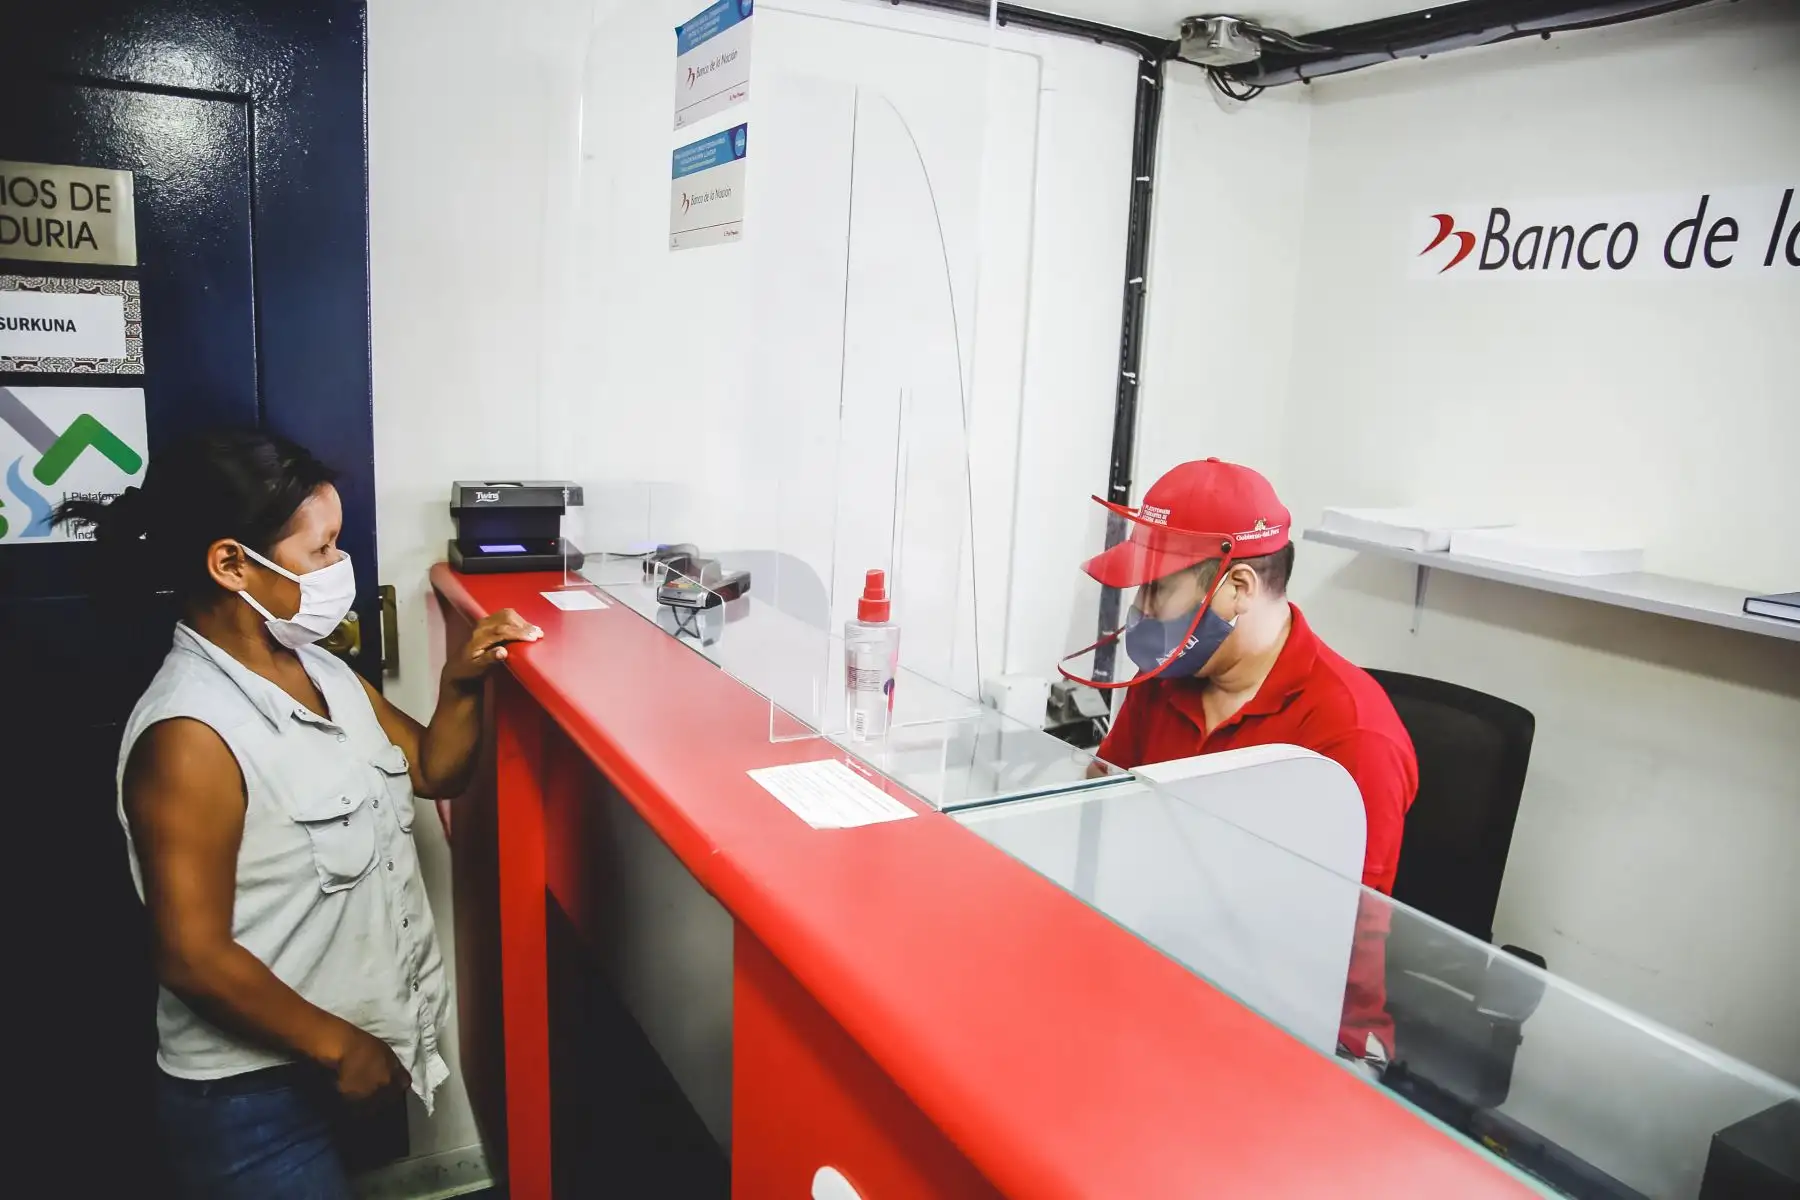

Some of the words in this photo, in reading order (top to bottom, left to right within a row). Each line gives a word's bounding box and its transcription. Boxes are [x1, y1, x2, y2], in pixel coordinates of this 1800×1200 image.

[69, 182, 111, 213] DE
[691, 194, 703, 206] Banco
[0, 214, 98, 250] DURIA
[1478, 207, 1639, 271] Banco
[1663, 194, 1740, 270] de
